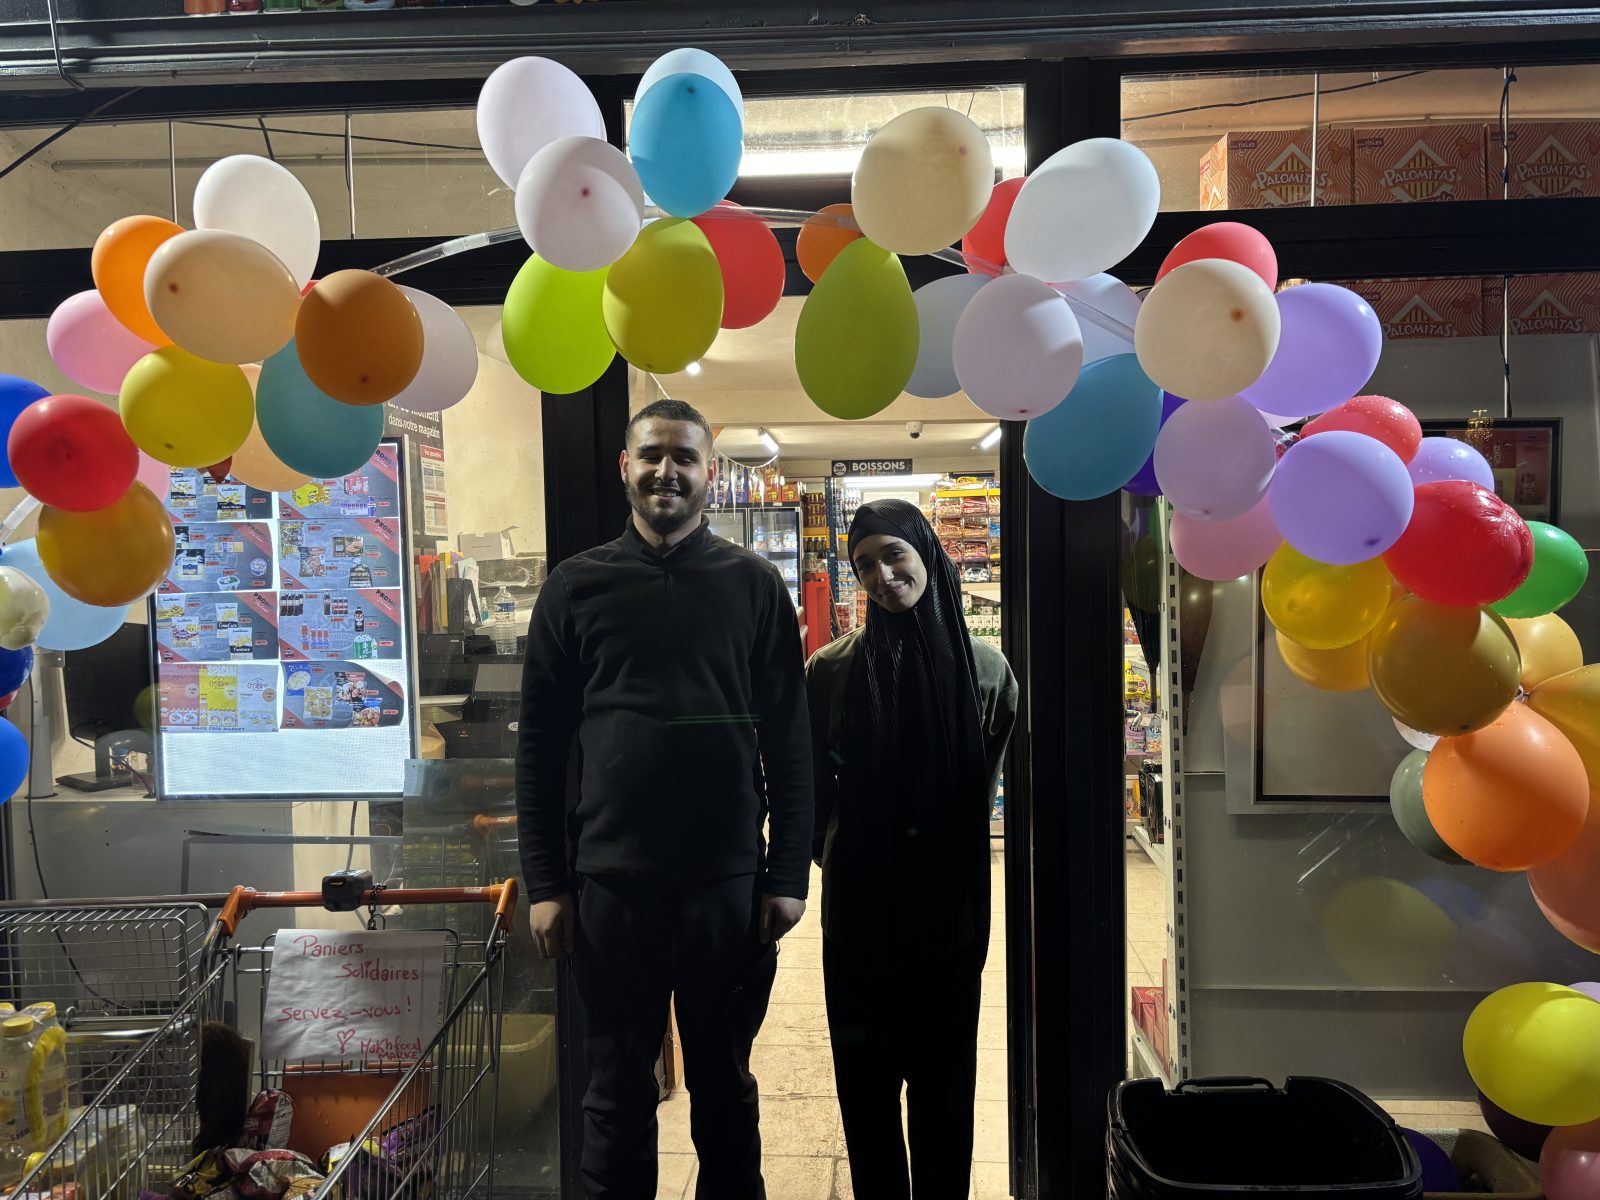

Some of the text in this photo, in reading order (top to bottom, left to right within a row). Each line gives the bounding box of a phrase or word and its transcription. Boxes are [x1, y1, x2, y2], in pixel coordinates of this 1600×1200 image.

[1383, 165, 1457, 187] PALOMITAS
[1516, 161, 1587, 181] PALOMITAS
[388, 412, 403, 428] dans
[402, 419, 418, 432] votre
[852, 461, 906, 471] BOISSONS
[293, 934, 365, 958] Paniers
[335, 958, 420, 982] Solidaires
